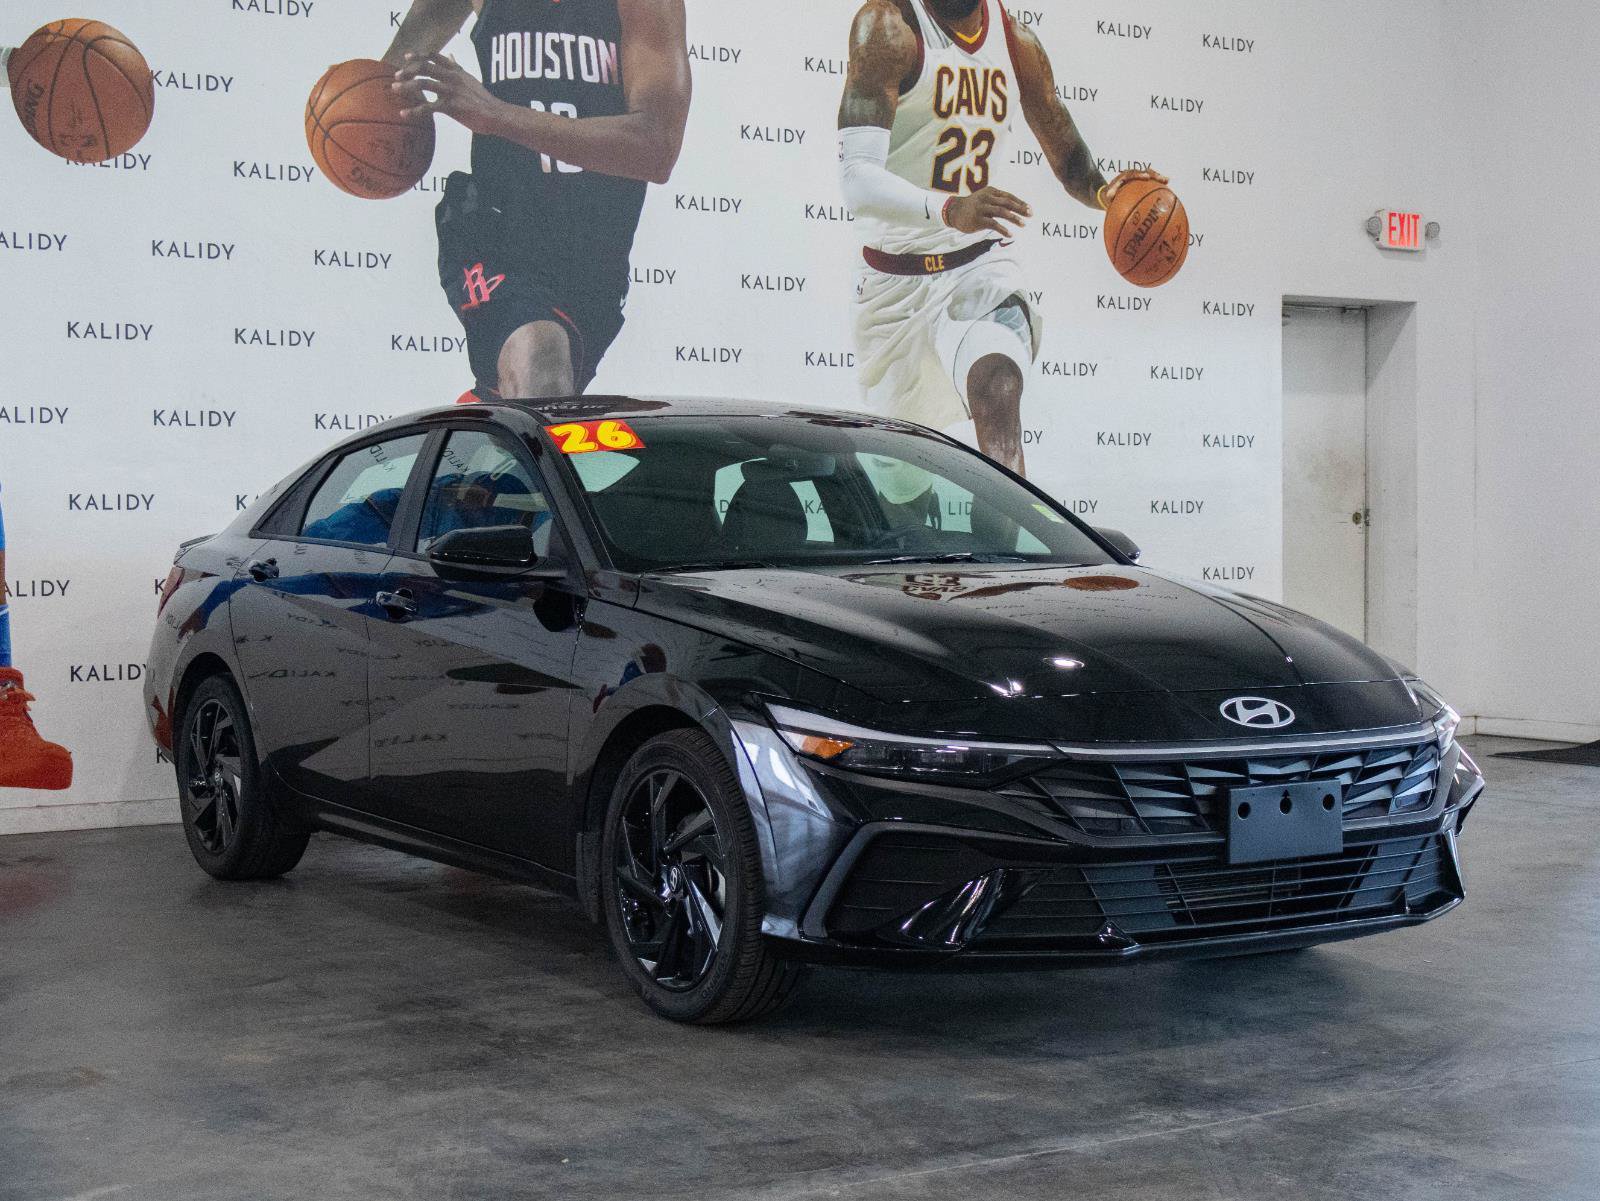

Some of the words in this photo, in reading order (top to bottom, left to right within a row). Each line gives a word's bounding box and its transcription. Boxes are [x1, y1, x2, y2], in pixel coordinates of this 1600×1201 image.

[232, 0, 314, 18] KALIDY
[1097, 20, 1152, 40] KALIDY
[1202, 33, 1255, 53] KALIDY
[491, 31, 619, 85] HOUSTON
[689, 45, 742, 64] ALIDY
[805, 57, 845, 76] KALI
[150, 70, 234, 93] KALIDY
[933, 64, 1008, 123] CAVS
[1054, 85, 1098, 103] ALIDY
[1150, 95, 1204, 114] KALIDY
[740, 124, 806, 145] KALIDY
[931, 125, 995, 195] 23
[233, 160, 314, 183] KALIDY
[1202, 167, 1255, 185] KALIDY
[675, 194, 742, 214] KALIDY
[1042, 221, 1098, 240] KALIDY
[1388, 212, 1421, 249] EXIT
[0, 231, 68, 252] ALIDY
[151, 239, 235, 260] KALIDY
[314, 249, 392, 270] KALIDY
[924, 255, 945, 272] CLE
[634, 268, 677, 285] LIDY
[741, 274, 806, 292] KALIDY
[1097, 294, 1152, 311] KALIDY
[1202, 300, 1255, 317] KALIDY
[67, 321, 153, 341] KALIDY
[234, 327, 316, 348] KALIDY
[391, 334, 466, 353] KALIDY
[675, 345, 742, 363] KALIDY
[805, 351, 855, 368] KALID
[1042, 361, 1098, 377] KALIDY
[1150, 365, 1204, 381] KALIDY
[0, 405, 69, 425] ALIDY
[153, 409, 236, 427] KALIDY
[550, 419, 635, 454] 26
[1097, 431, 1152, 446] KALIDY
[1202, 434, 1255, 449] KALIDY
[69, 493, 155, 511] KALIDY
[1150, 500, 1204, 514] KALIDY
[1202, 566, 1255, 581] KALIDY
[70, 663, 146, 683] KALID
